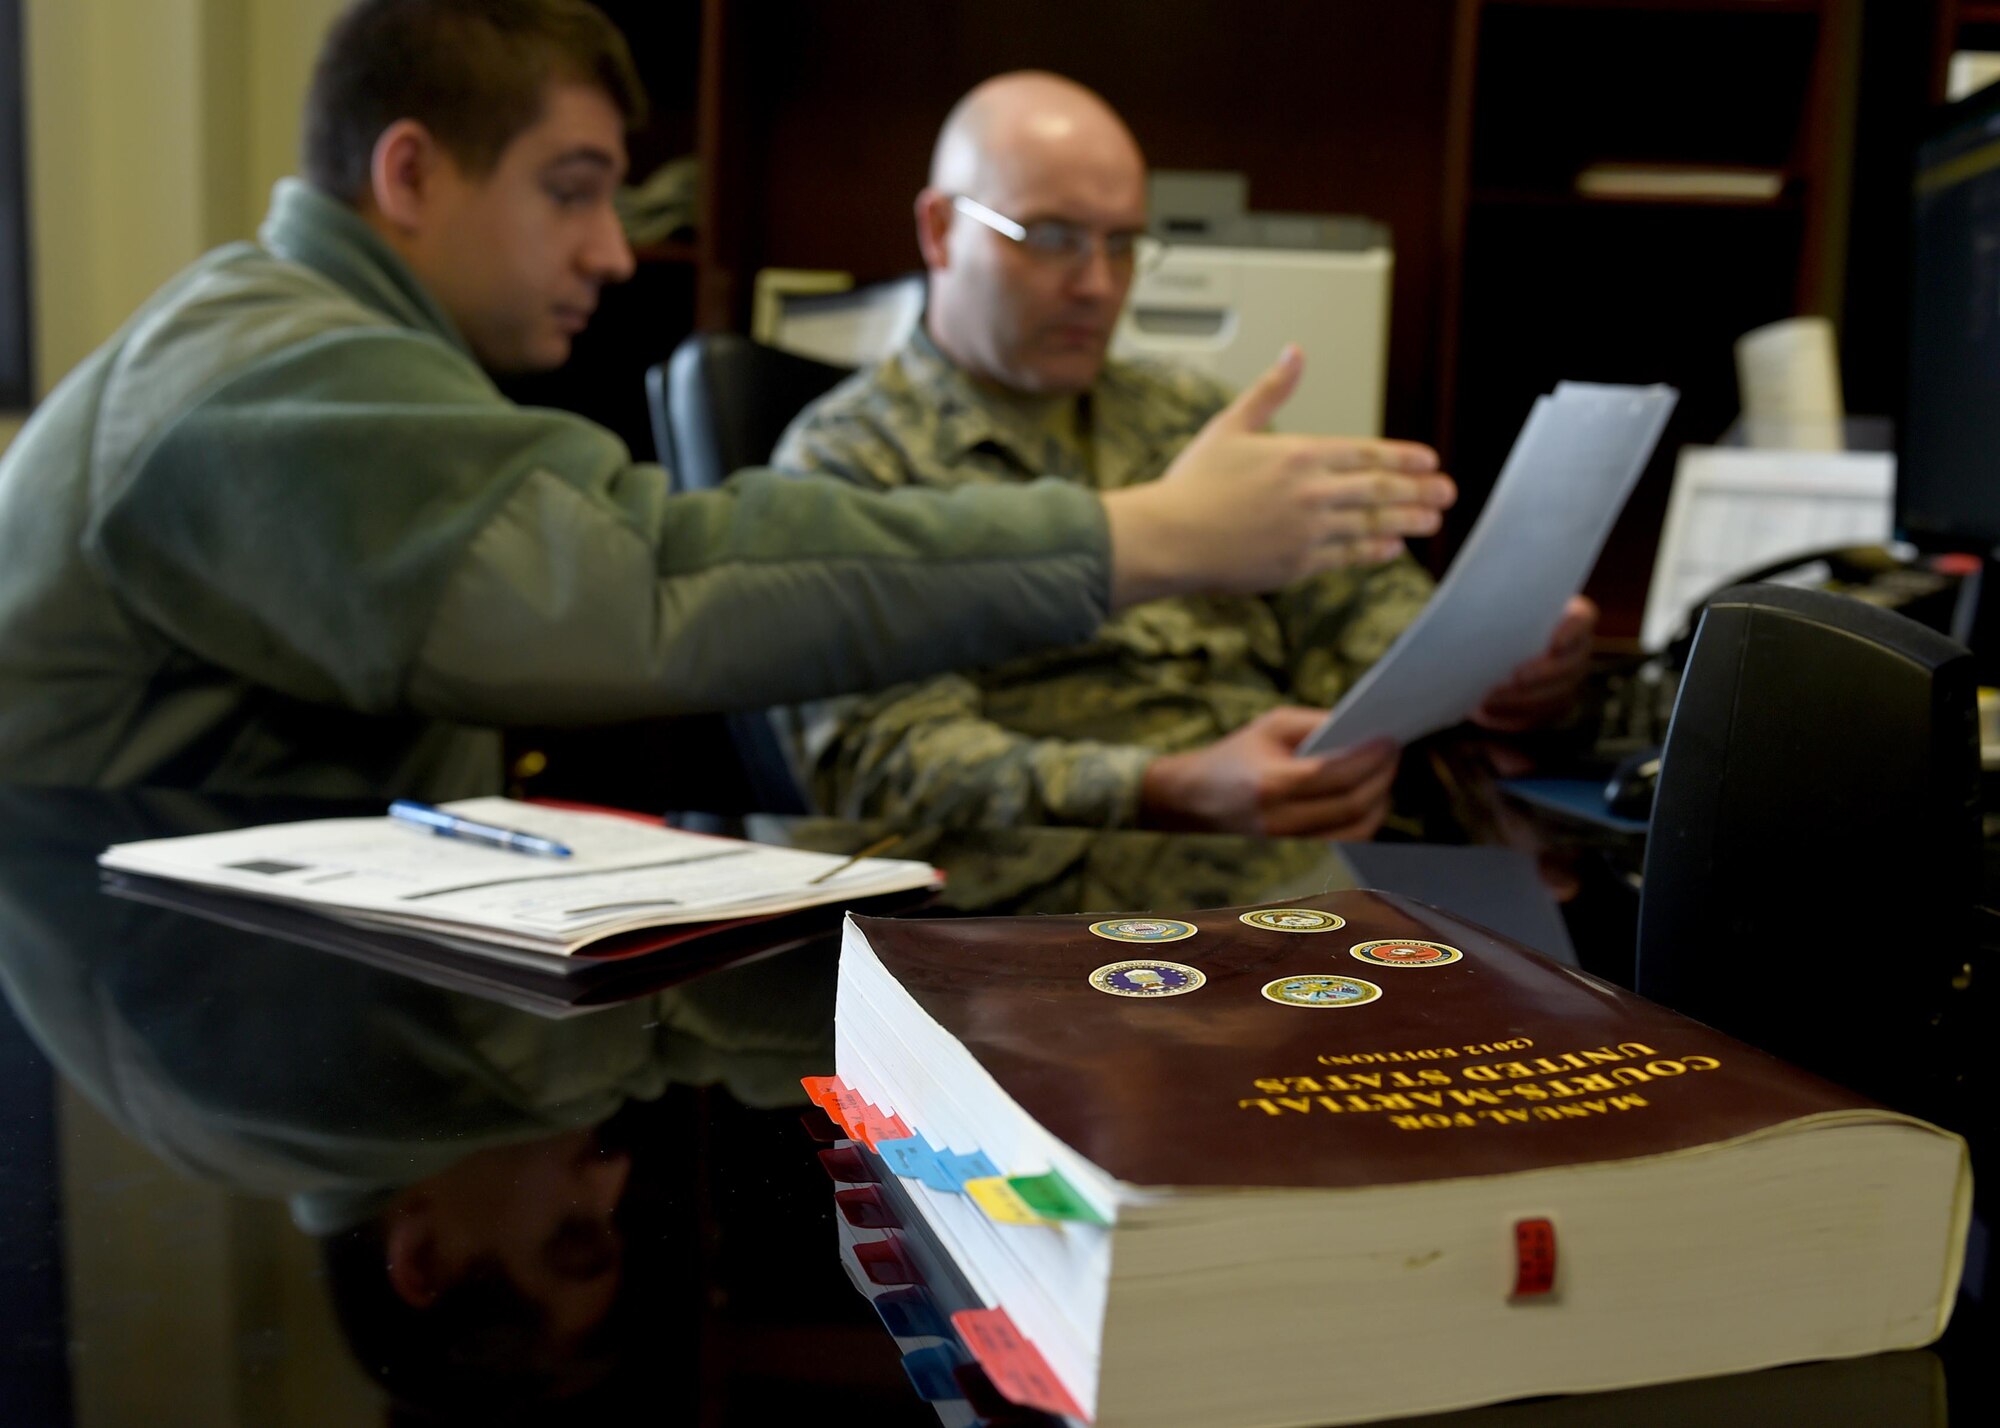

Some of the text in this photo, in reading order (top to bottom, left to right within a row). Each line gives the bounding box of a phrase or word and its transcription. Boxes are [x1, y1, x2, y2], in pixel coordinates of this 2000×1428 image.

[1253, 1042, 1658, 1094] UNITED STATES
[1317, 1037, 1534, 1066] (2012 EDITION)
[1239, 1055, 1721, 1116] COURTS-MARTIAL
[1389, 1092, 1648, 1130] MANUAL FOR
